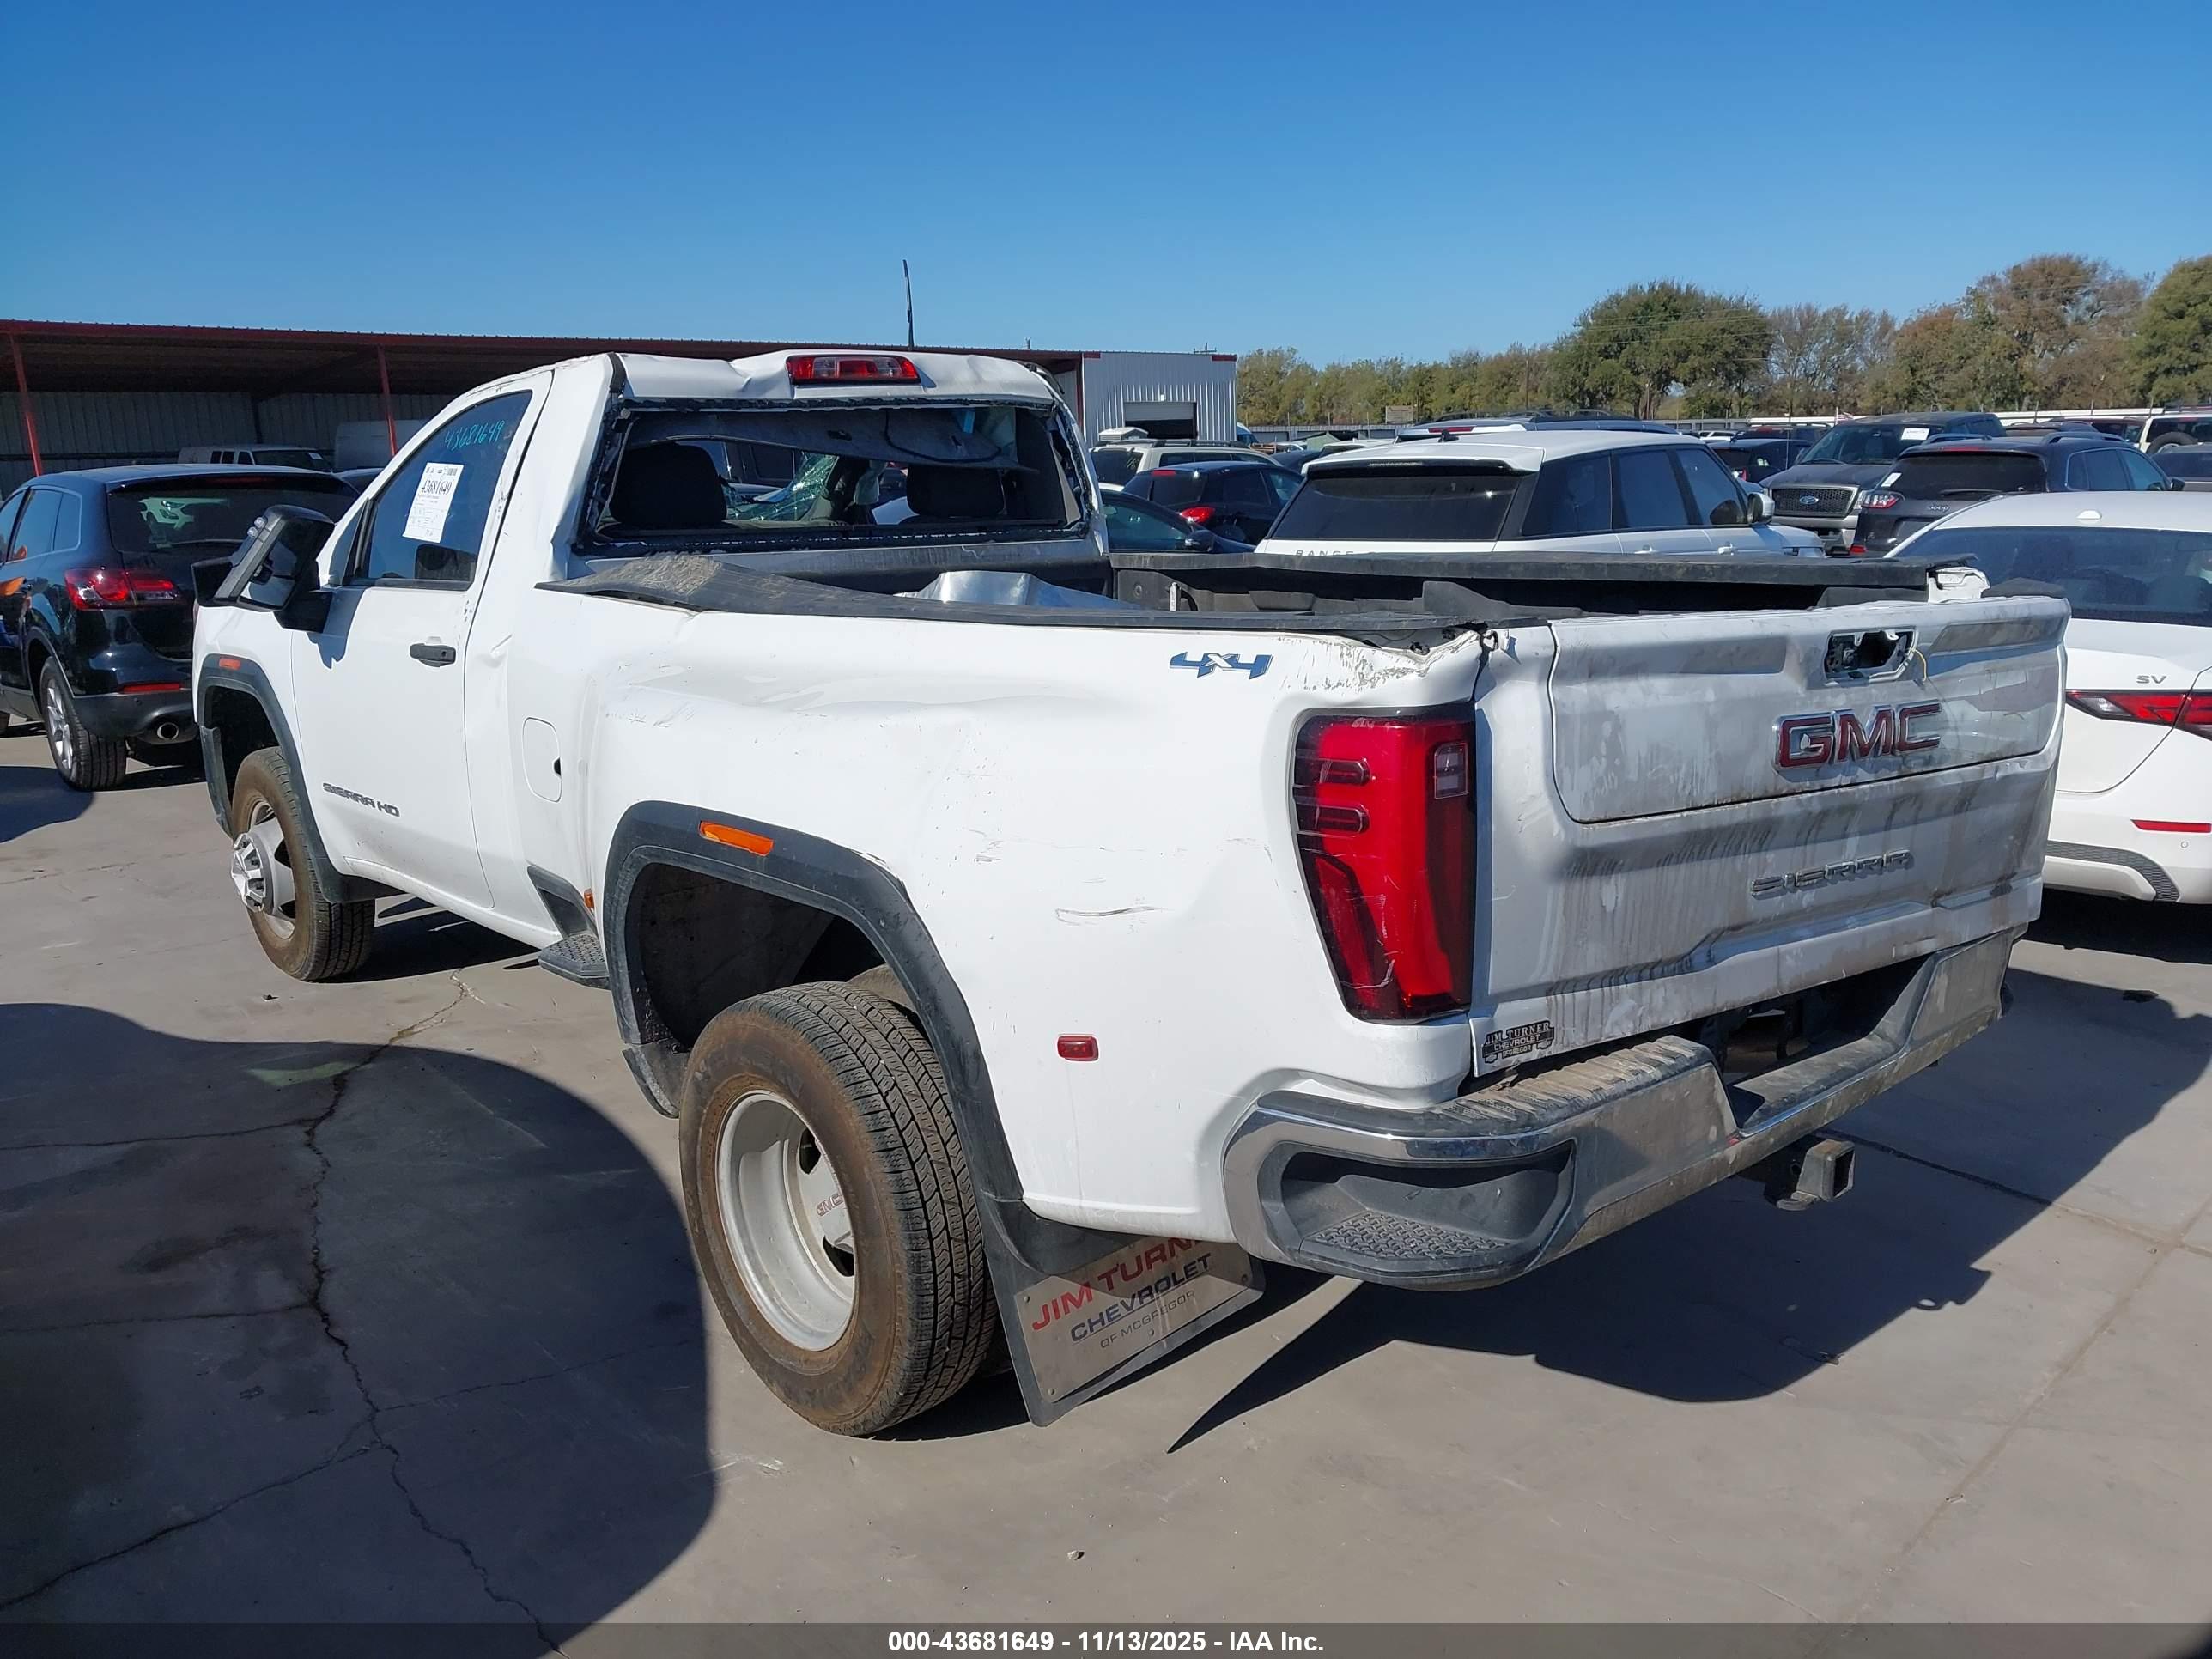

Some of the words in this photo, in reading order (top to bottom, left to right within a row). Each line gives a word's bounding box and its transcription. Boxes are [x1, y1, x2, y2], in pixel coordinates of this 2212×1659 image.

[444, 420, 505, 452] 43681649
[422, 480, 453, 495] 43681649
[2136, 674, 2168, 684] SV
[1772, 698, 1942, 770] GMC
[322, 781, 376, 810] SIERRA
[376, 799, 401, 818] HD
[1749, 848, 1914, 898] SIERRA
[1486, 1032, 1502, 1045] JIM
[1507, 1022, 1550, 1039] TURNER
[1493, 1034, 1540, 1051] CHEVROLET
[816, 1194, 844, 1217] GMC
[1032, 1281, 1094, 1331] JIM
[1070, 1252, 1212, 1343] CHEVROLET
[1100, 1334, 1118, 1349] OF
